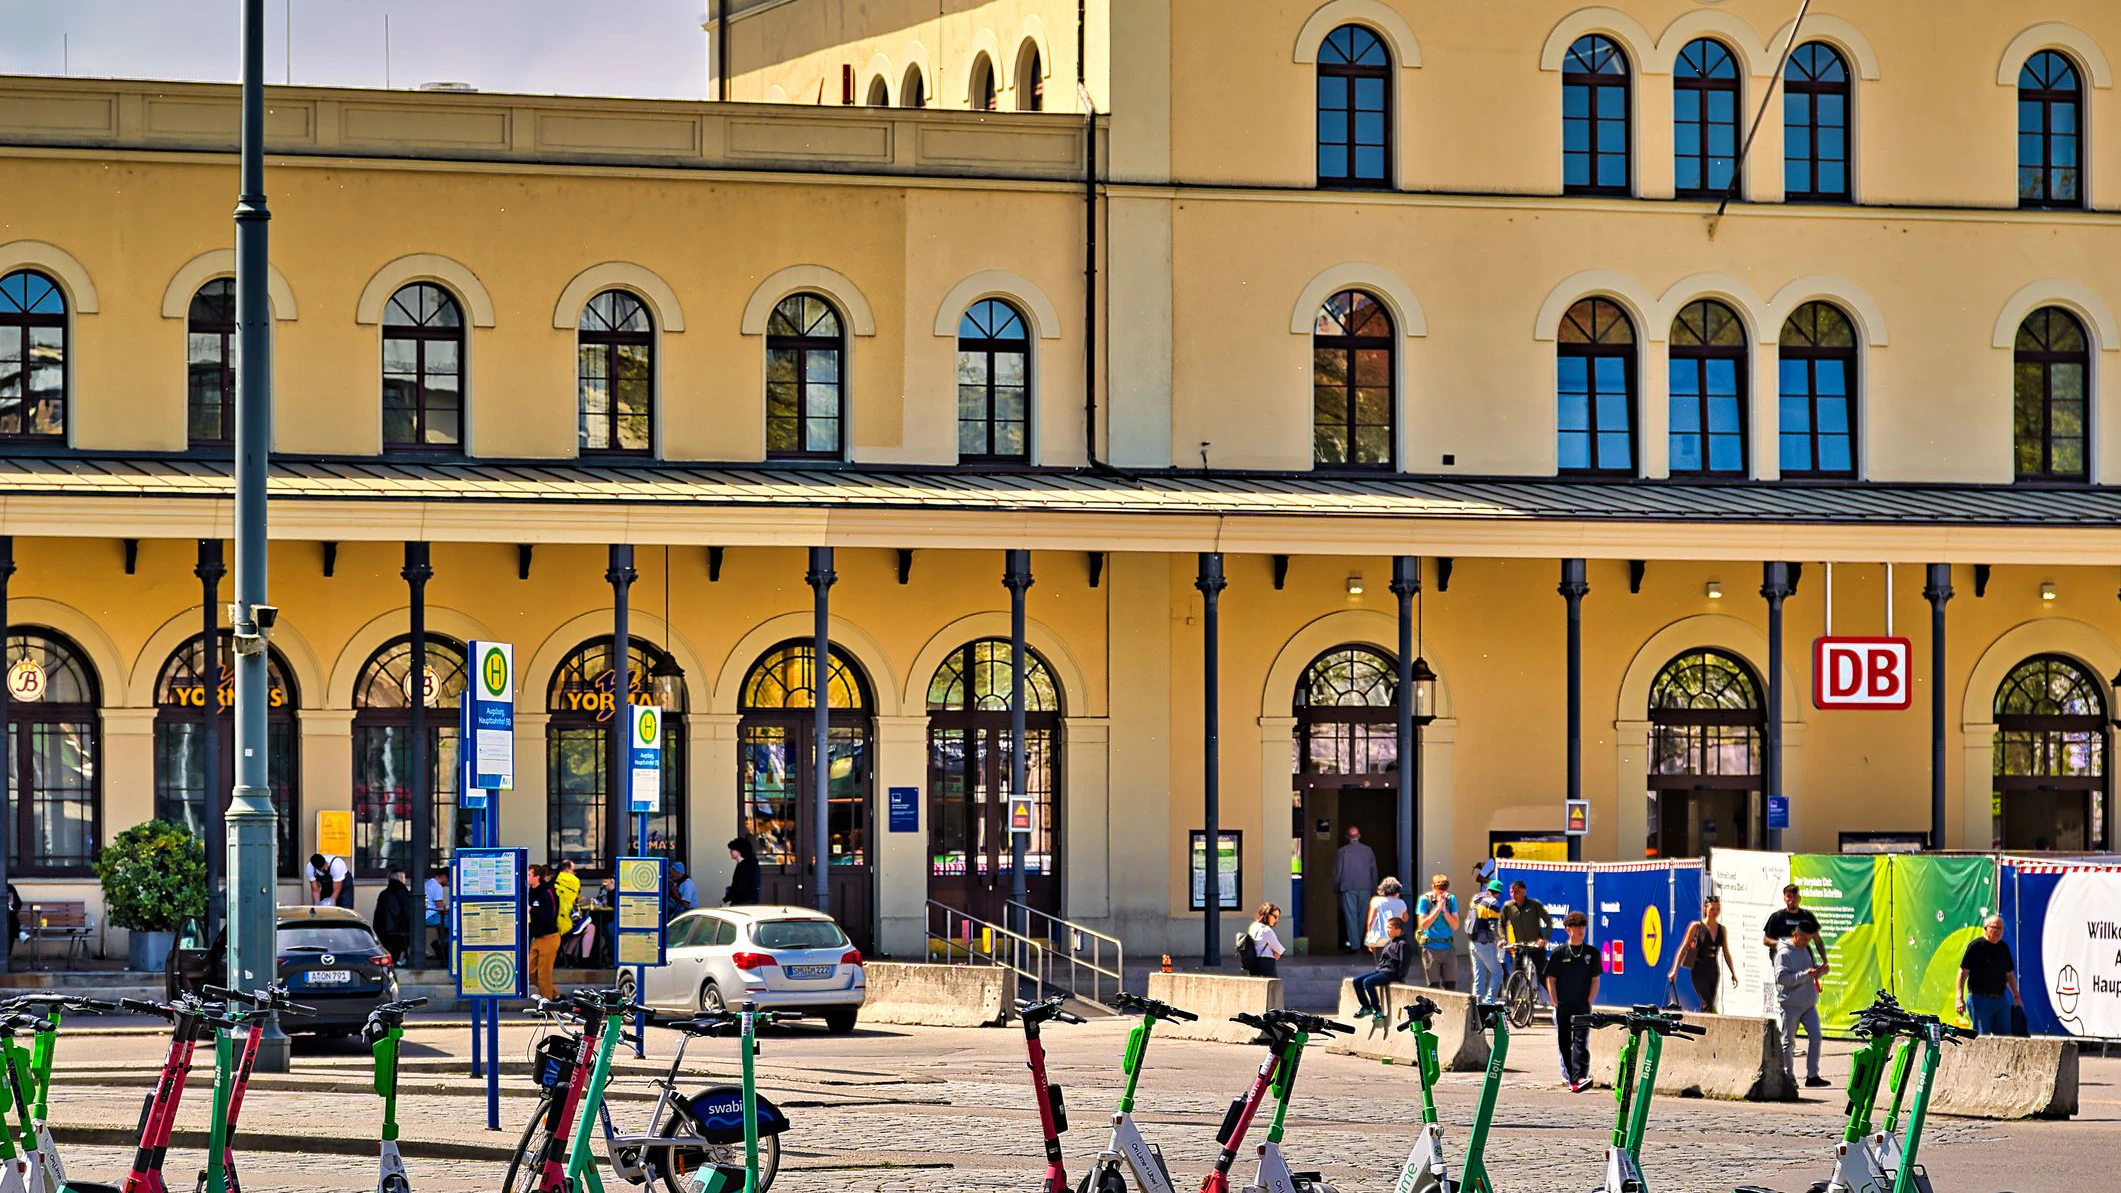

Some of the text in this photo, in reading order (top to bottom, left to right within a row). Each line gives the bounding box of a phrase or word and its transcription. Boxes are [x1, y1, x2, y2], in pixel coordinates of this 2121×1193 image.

[1829, 648, 1901, 698] DB
[2087, 920, 2121, 940] Willk
[332, 971, 347, 980] 791
[214, 1066, 222, 1088] Bolt
[1490, 1059, 1502, 1080] Bolt
[1642, 1059, 1653, 1080] Bolt
[1917, 1071, 1927, 1093] Bolt
[708, 1100, 743, 1114] swabi
